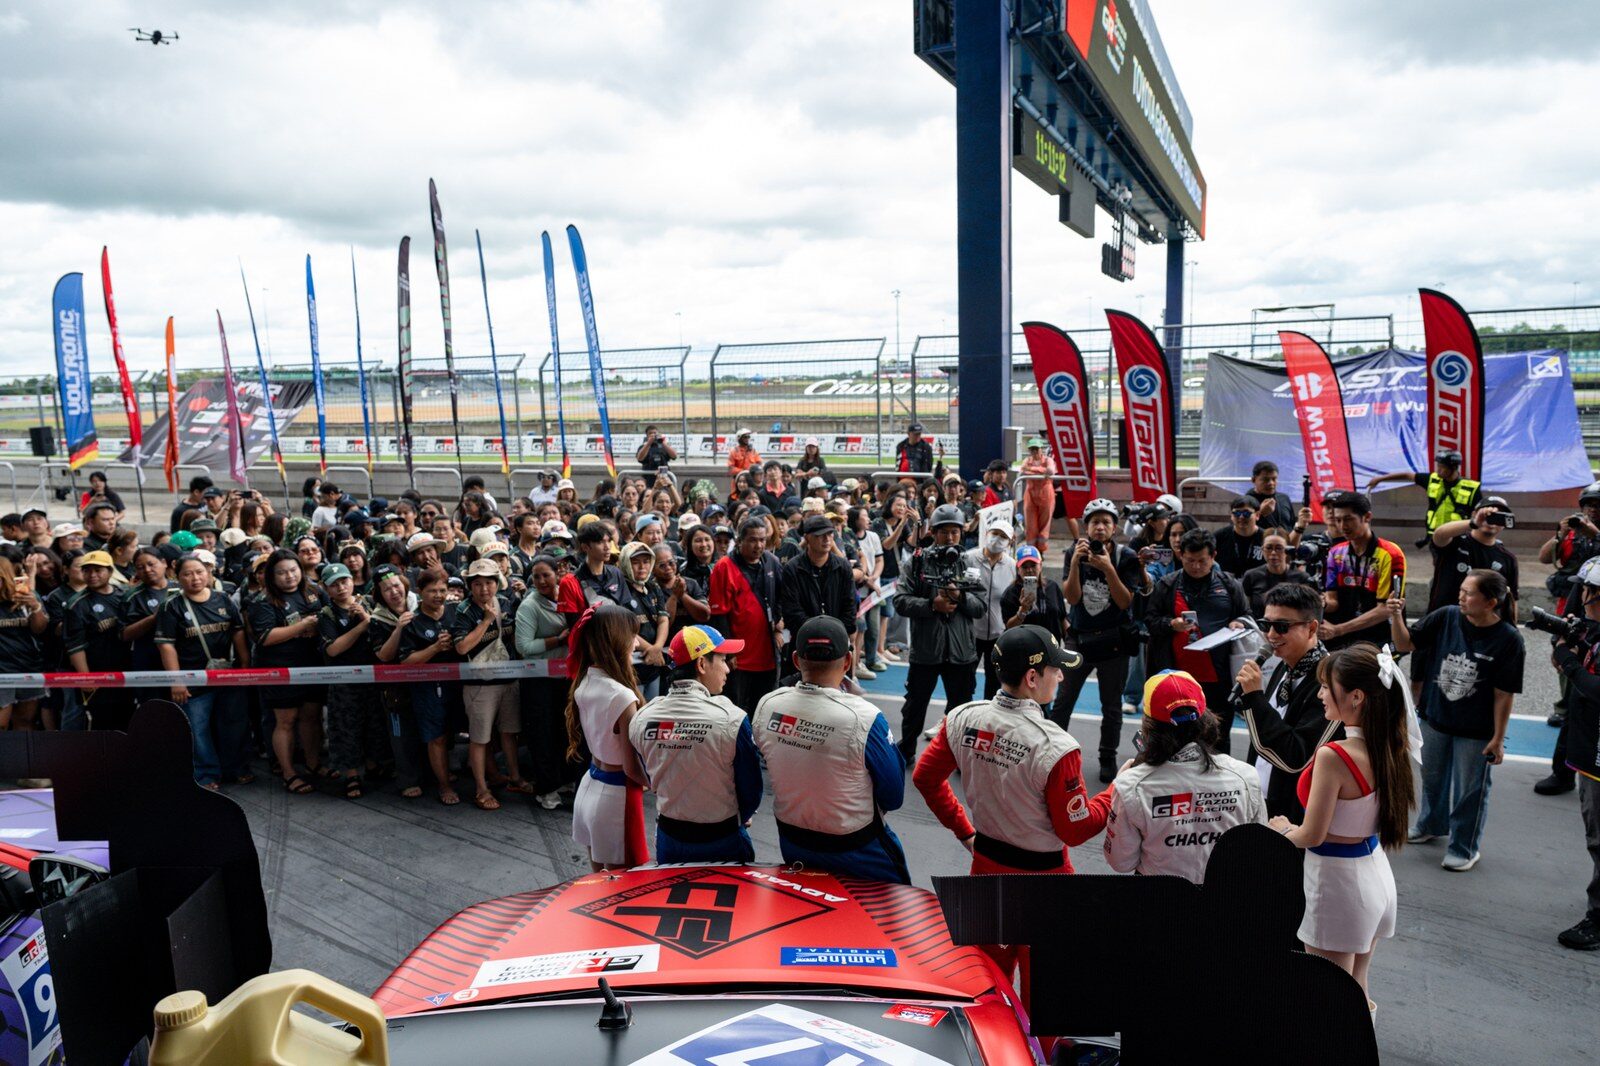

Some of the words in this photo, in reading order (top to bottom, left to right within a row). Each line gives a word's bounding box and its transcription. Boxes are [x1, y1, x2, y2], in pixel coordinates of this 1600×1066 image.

[1132, 397, 1166, 491] Trane
[767, 719, 794, 735] GR
[796, 725, 828, 738] GAZOO
[799, 718, 835, 733] TOYOTA
[645, 728, 672, 740] GR
[672, 734, 705, 743] Racing
[793, 732, 826, 745] Racing
[777, 736, 812, 750] Thailand
[962, 735, 991, 751] GR
[994, 742, 1025, 757] GAZOO
[996, 734, 1032, 753] TOYOTA
[992, 748, 1021, 765] Racing
[1195, 798, 1237, 806] GAZOO
[1197, 790, 1241, 799] TOYOTA
[1153, 801, 1191, 817] GR
[1194, 805, 1236, 813] Racing
[1175, 816, 1222, 825] Thailand
[744, 870, 849, 904] ADVAN
[579, 893, 627, 915] SPORT
[20, 947, 39, 969] GR
[577, 954, 641, 969] GR
[818, 955, 887, 965] Lamina
